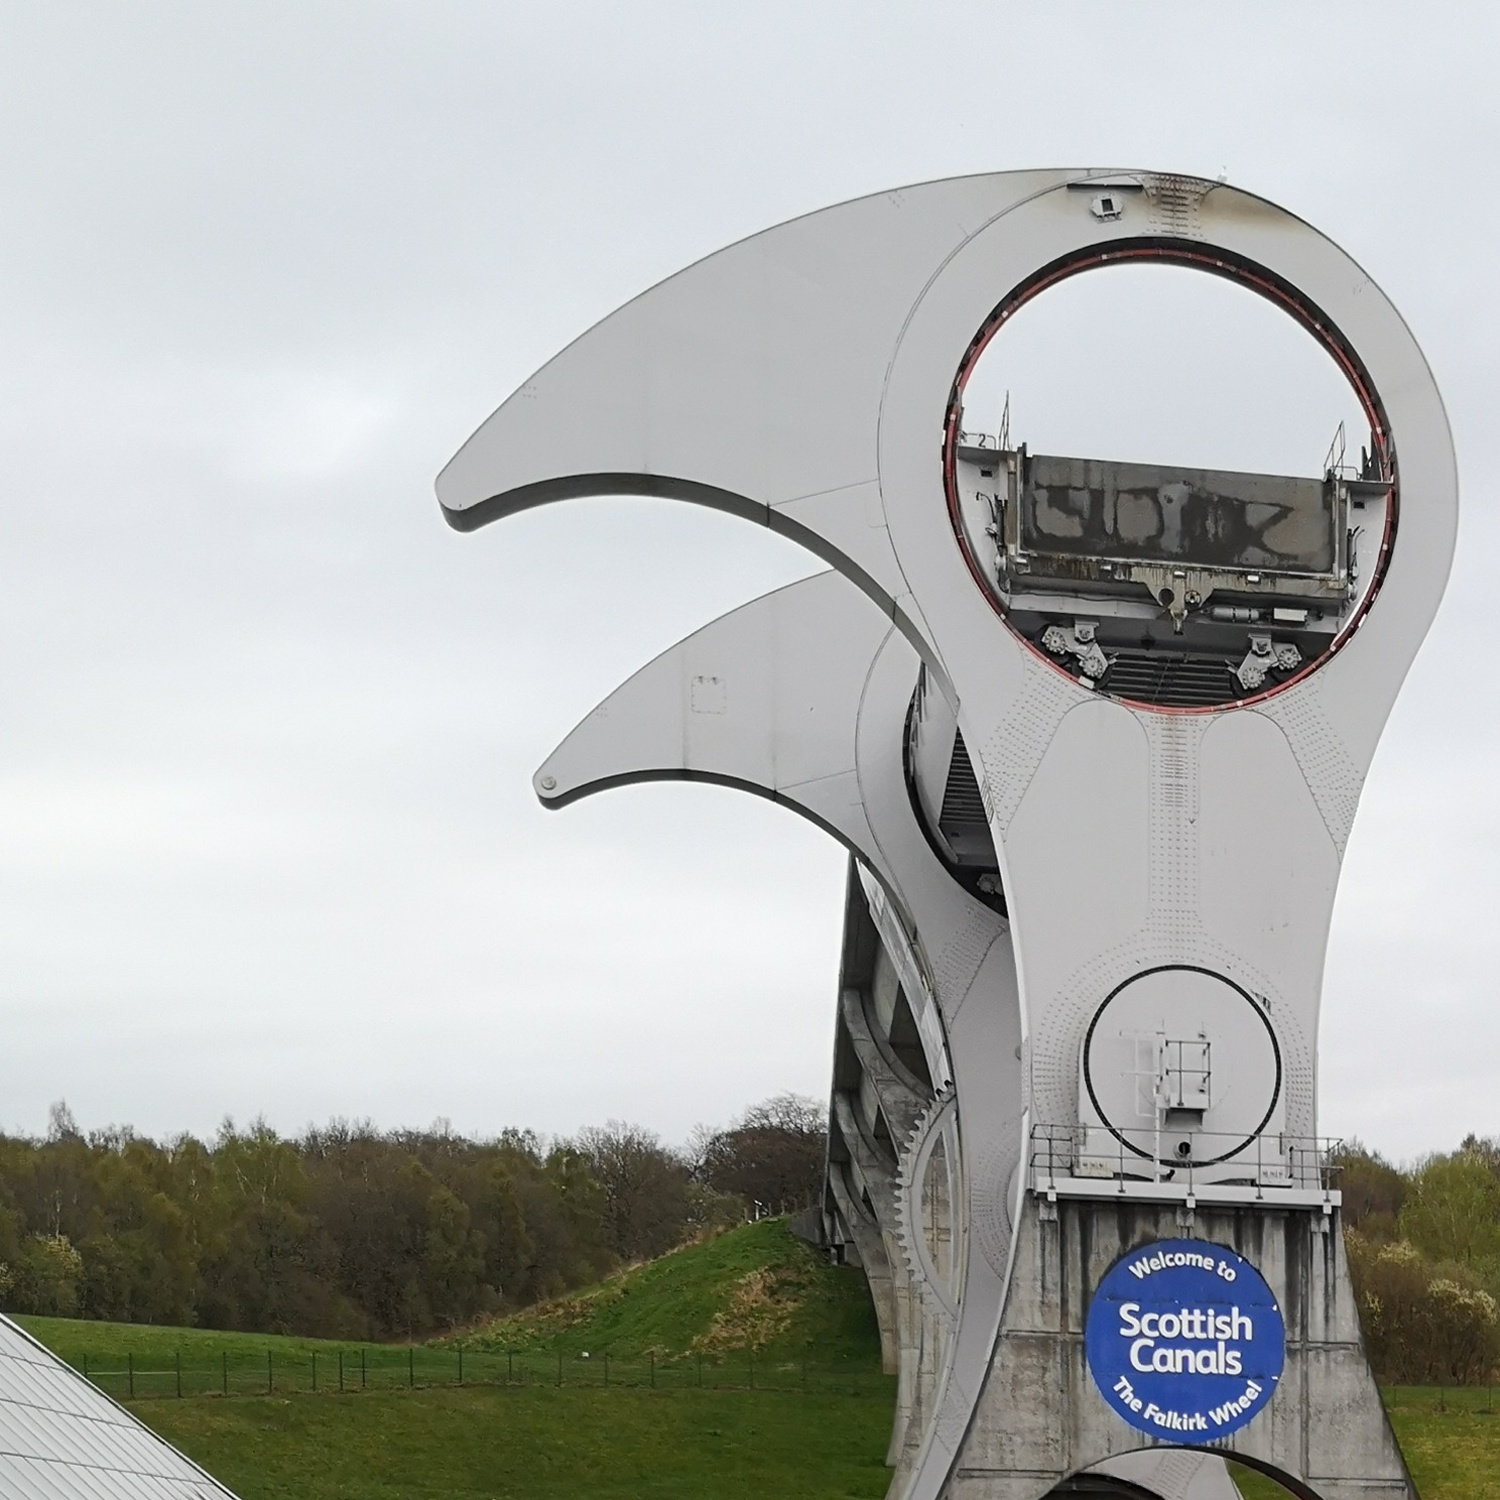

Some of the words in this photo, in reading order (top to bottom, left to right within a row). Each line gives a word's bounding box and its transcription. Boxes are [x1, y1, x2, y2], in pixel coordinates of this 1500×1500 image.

[1128, 1251, 1215, 1280] Welcome
[1217, 1261, 1237, 1282] to
[1119, 1303, 1253, 1341] Scottish
[1129, 1338, 1243, 1375] Canals
[1112, 1375, 1143, 1412] The
[1143, 1403, 1208, 1431] Falkirk
[1208, 1380, 1263, 1426] Wheel
